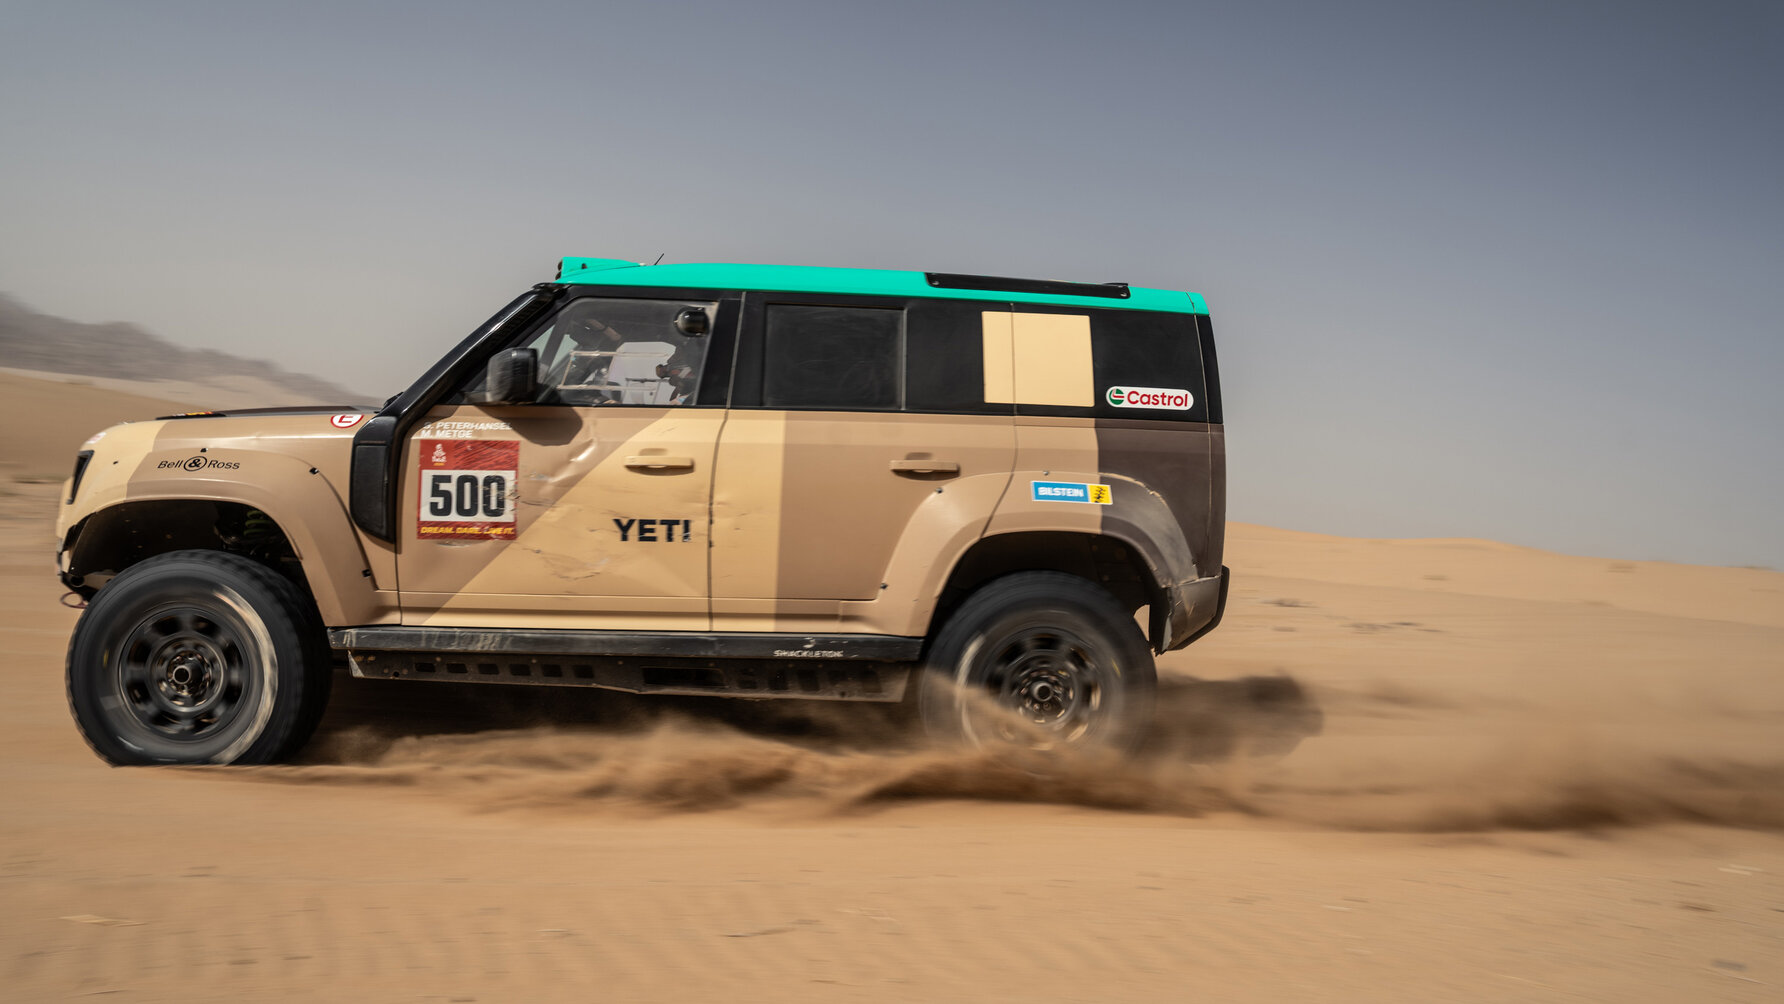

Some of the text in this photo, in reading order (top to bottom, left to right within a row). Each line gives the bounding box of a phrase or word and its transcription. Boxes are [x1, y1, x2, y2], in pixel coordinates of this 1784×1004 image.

[1127, 391, 1188, 407] Castrol
[420, 430, 473, 438] M. METGE
[157, 460, 183, 469] Bell
[207, 460, 240, 470] Ross
[430, 475, 505, 517] 500
[1038, 487, 1084, 497] BILSTEIN
